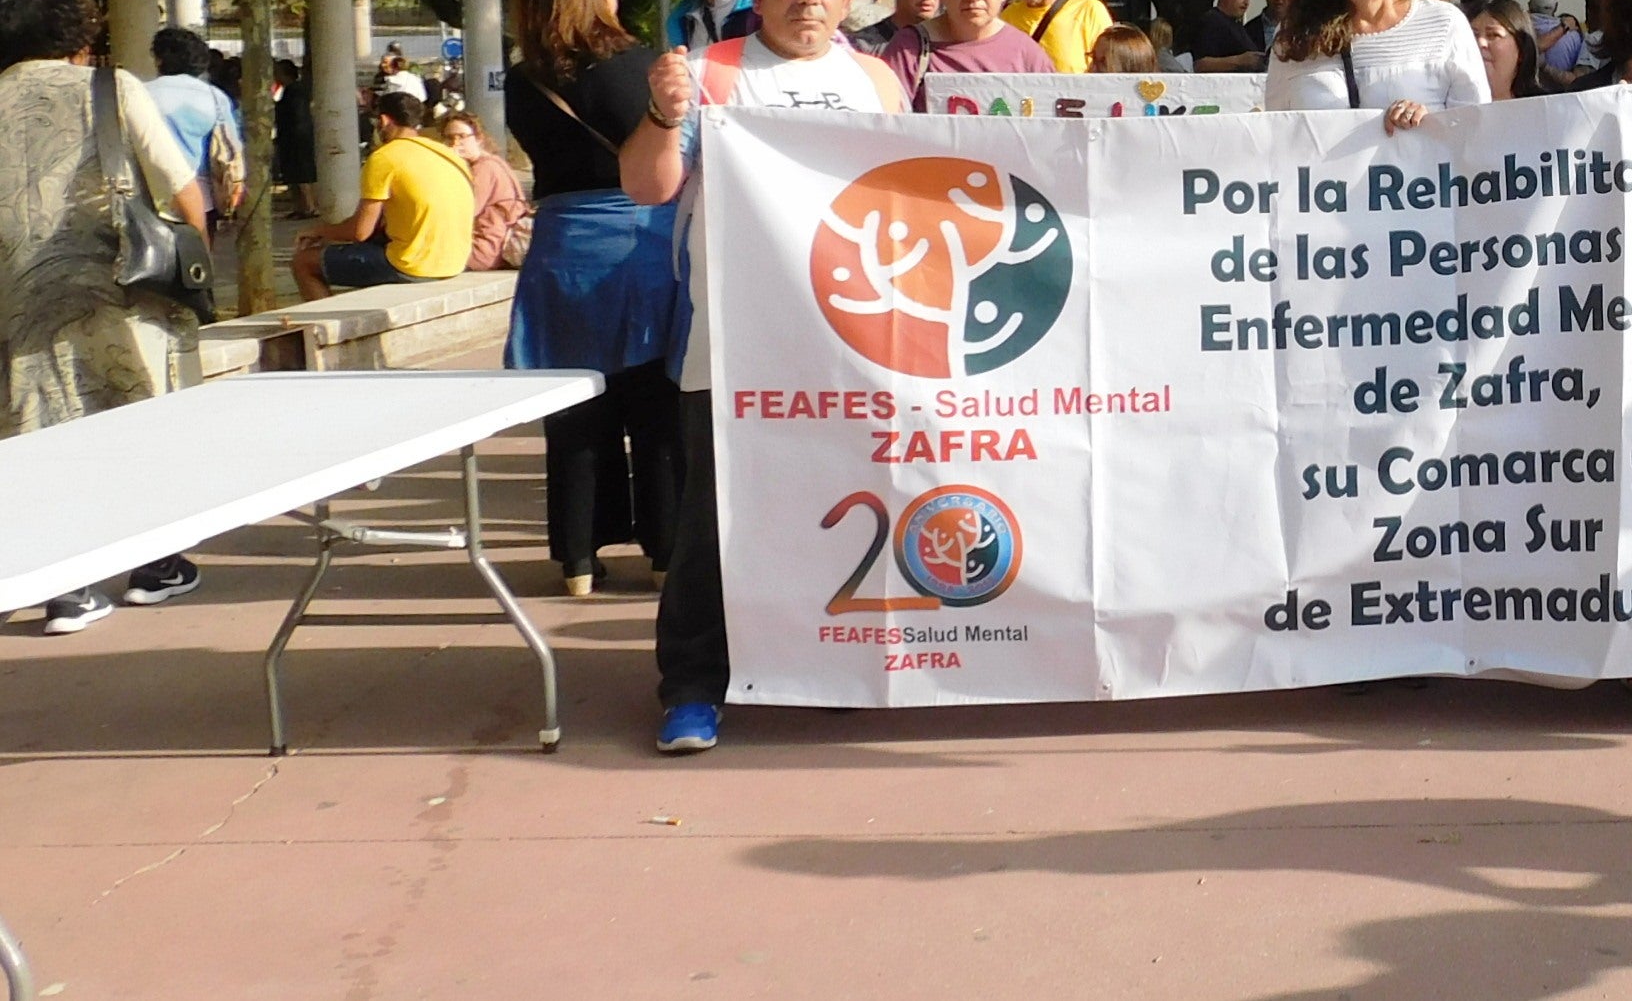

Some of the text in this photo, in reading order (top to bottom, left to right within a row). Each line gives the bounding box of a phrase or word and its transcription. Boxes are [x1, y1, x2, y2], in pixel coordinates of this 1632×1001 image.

[1182, 168, 1278, 214] Por
[1298, 166, 1347, 212] la
[1210, 234, 1277, 282] de
[1299, 233, 1369, 280] las
[1389, 224, 1623, 276] Personas
[1200, 288, 1540, 351] Enfermedad
[734, 390, 896, 420] FEAFES
[935, 388, 1038, 419] Salud
[1053, 385, 1171, 415] Mental
[1354, 355, 1600, 414] de Zafra,
[871, 429, 1038, 464] ZAFRA
[1302, 460, 1358, 500] su
[1377, 445, 1615, 494] Comarca
[1373, 503, 1603, 562] Zona Sur
[966, 625, 1028, 642] Mental
[1264, 589, 1332, 632] de
[884, 652, 961, 671] ZAFRA
